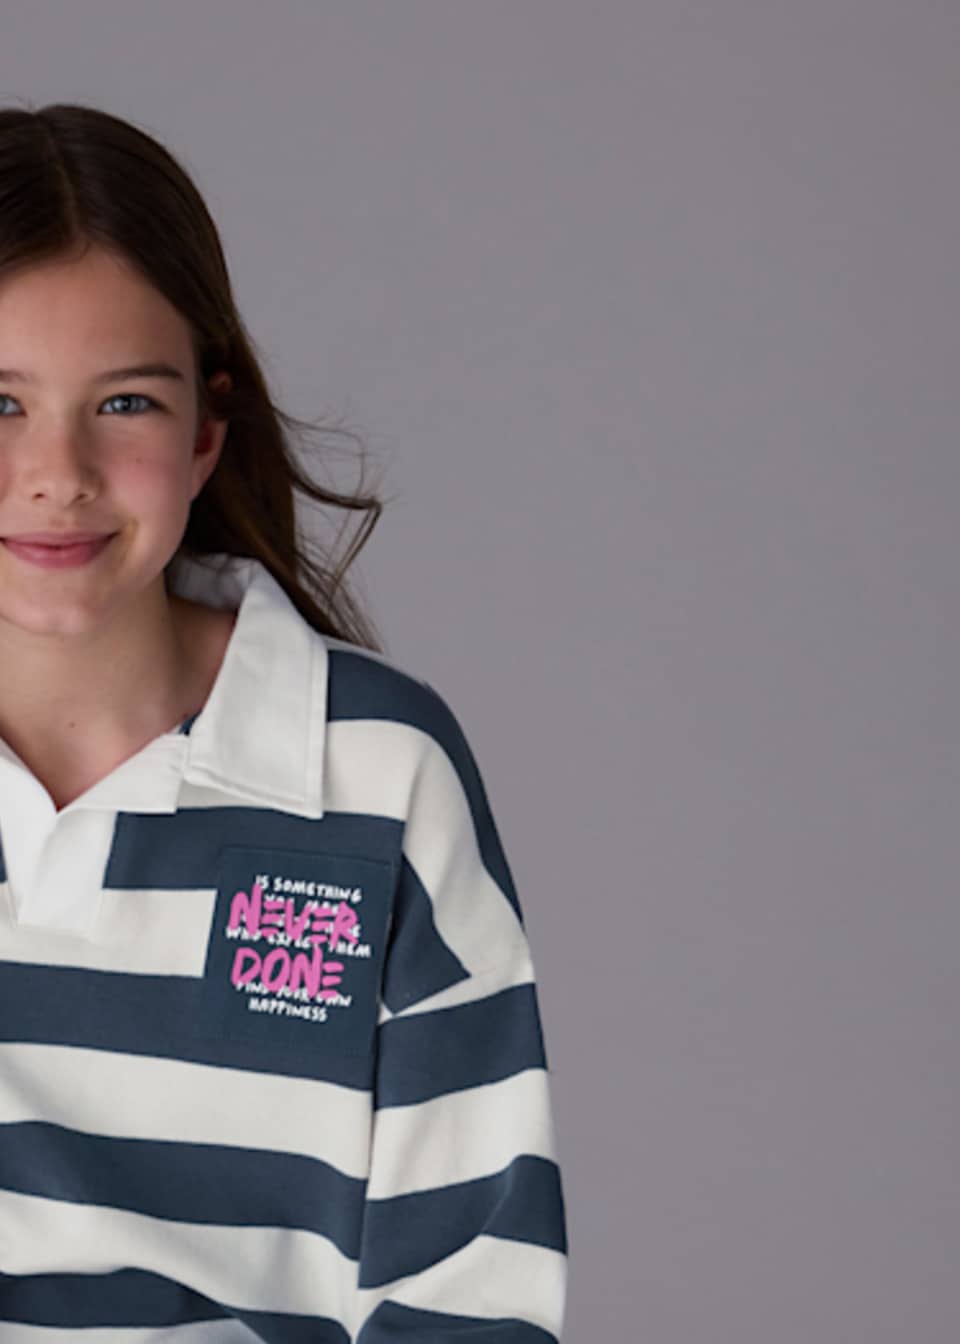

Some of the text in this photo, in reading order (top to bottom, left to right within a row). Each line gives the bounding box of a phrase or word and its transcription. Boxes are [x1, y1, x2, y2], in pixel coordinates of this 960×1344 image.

[274, 877, 362, 903] SOMETHING
[229, 883, 359, 949] NEVER
[231, 945, 345, 998] DONE
[248, 998, 328, 1023] HAPPINESS
